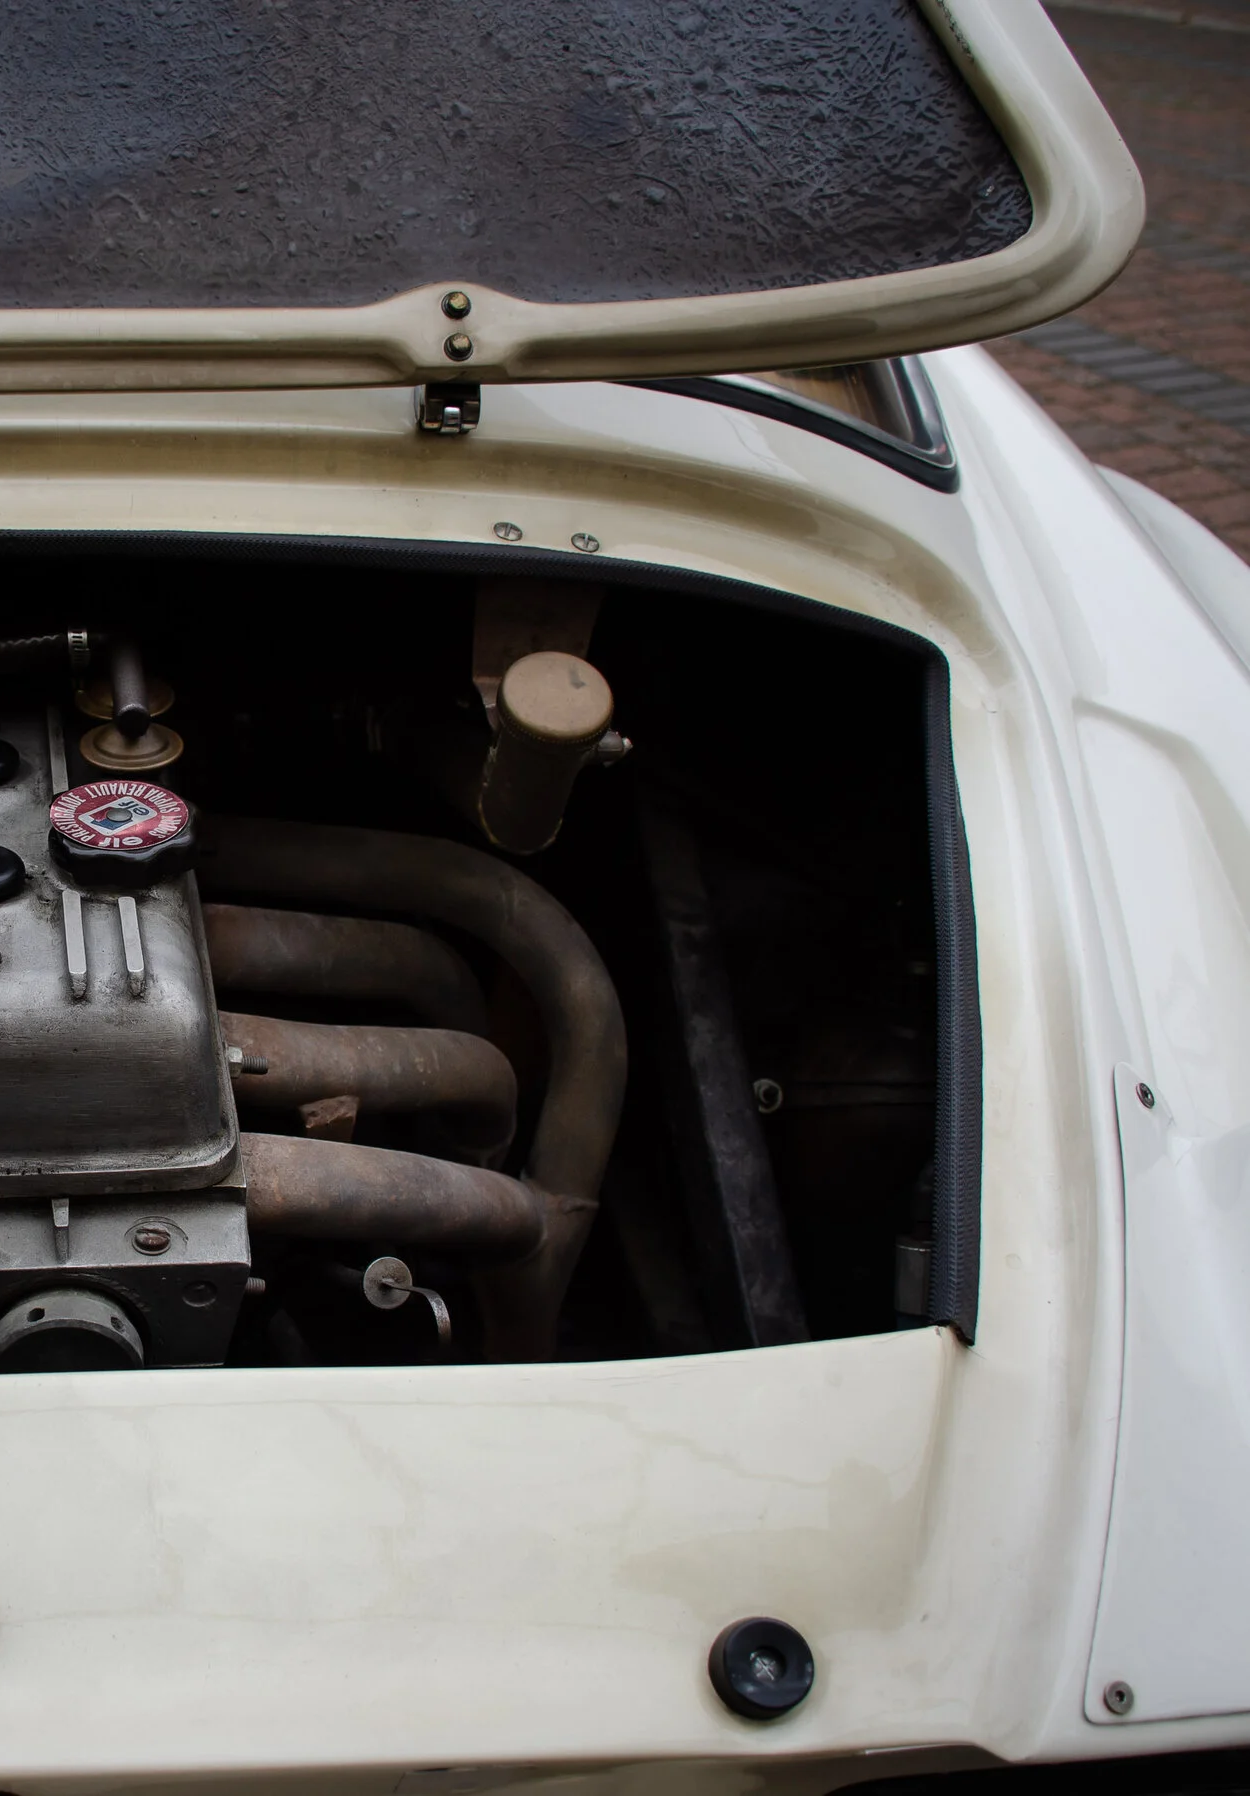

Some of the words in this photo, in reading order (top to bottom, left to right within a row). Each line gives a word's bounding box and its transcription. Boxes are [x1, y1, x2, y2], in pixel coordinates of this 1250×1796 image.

[84, 783, 144, 799] RENAULT
[142, 788, 180, 814] SUPRA
[53, 791, 97, 842] PRESTIGRADE
[118, 800, 149, 815] elf
